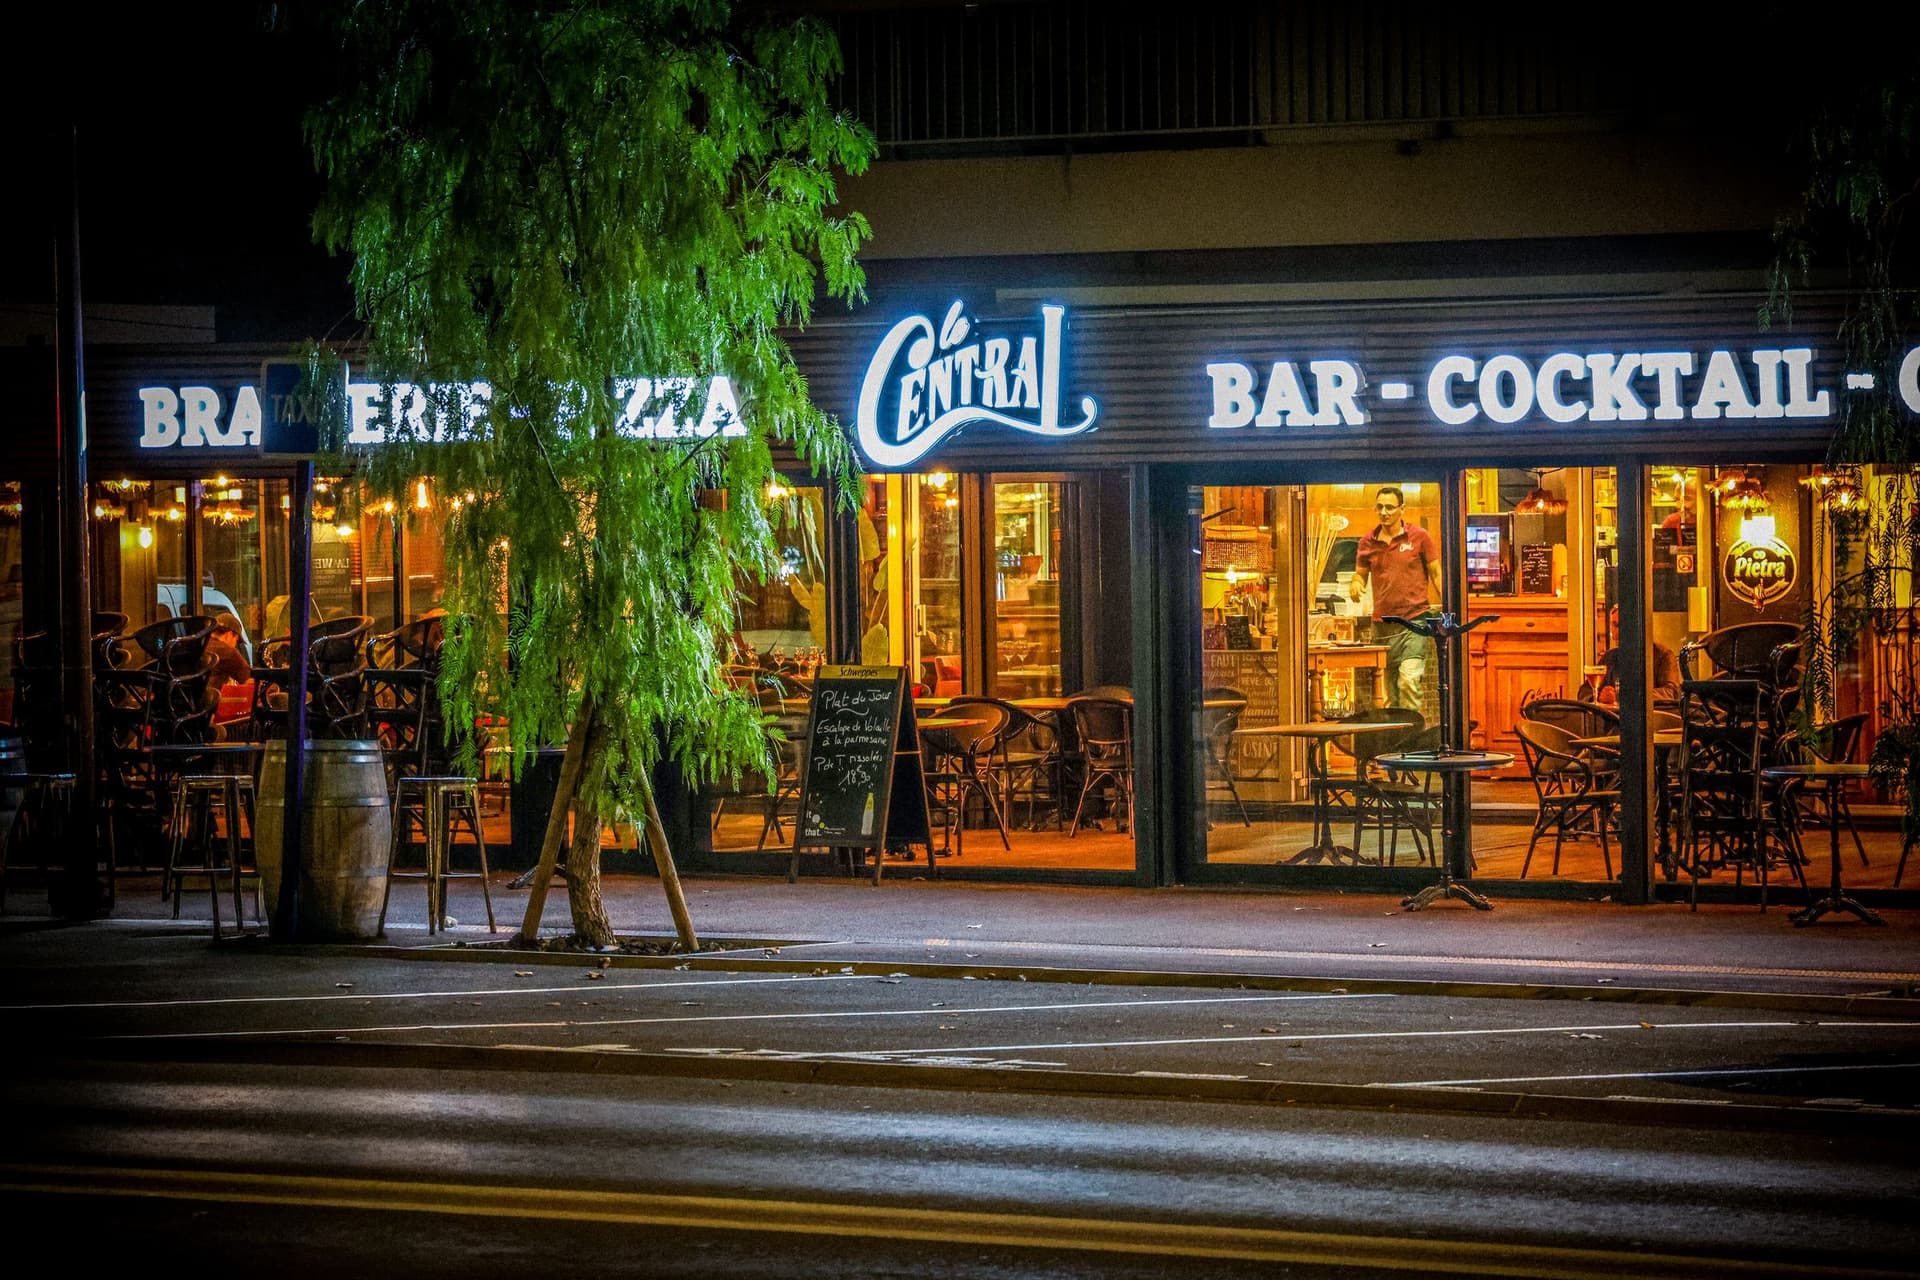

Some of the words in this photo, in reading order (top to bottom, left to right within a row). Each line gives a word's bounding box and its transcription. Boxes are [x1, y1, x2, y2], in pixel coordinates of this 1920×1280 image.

[1207, 360, 1365, 428] BAR
[1427, 348, 1831, 424] COCKTAIL
[546, 375, 749, 441] PZZA
[1734, 557, 1787, 578] Pietra
[821, 690, 850, 710] Plat
[851, 691, 866, 705] du
[834, 734, 842, 745] la
